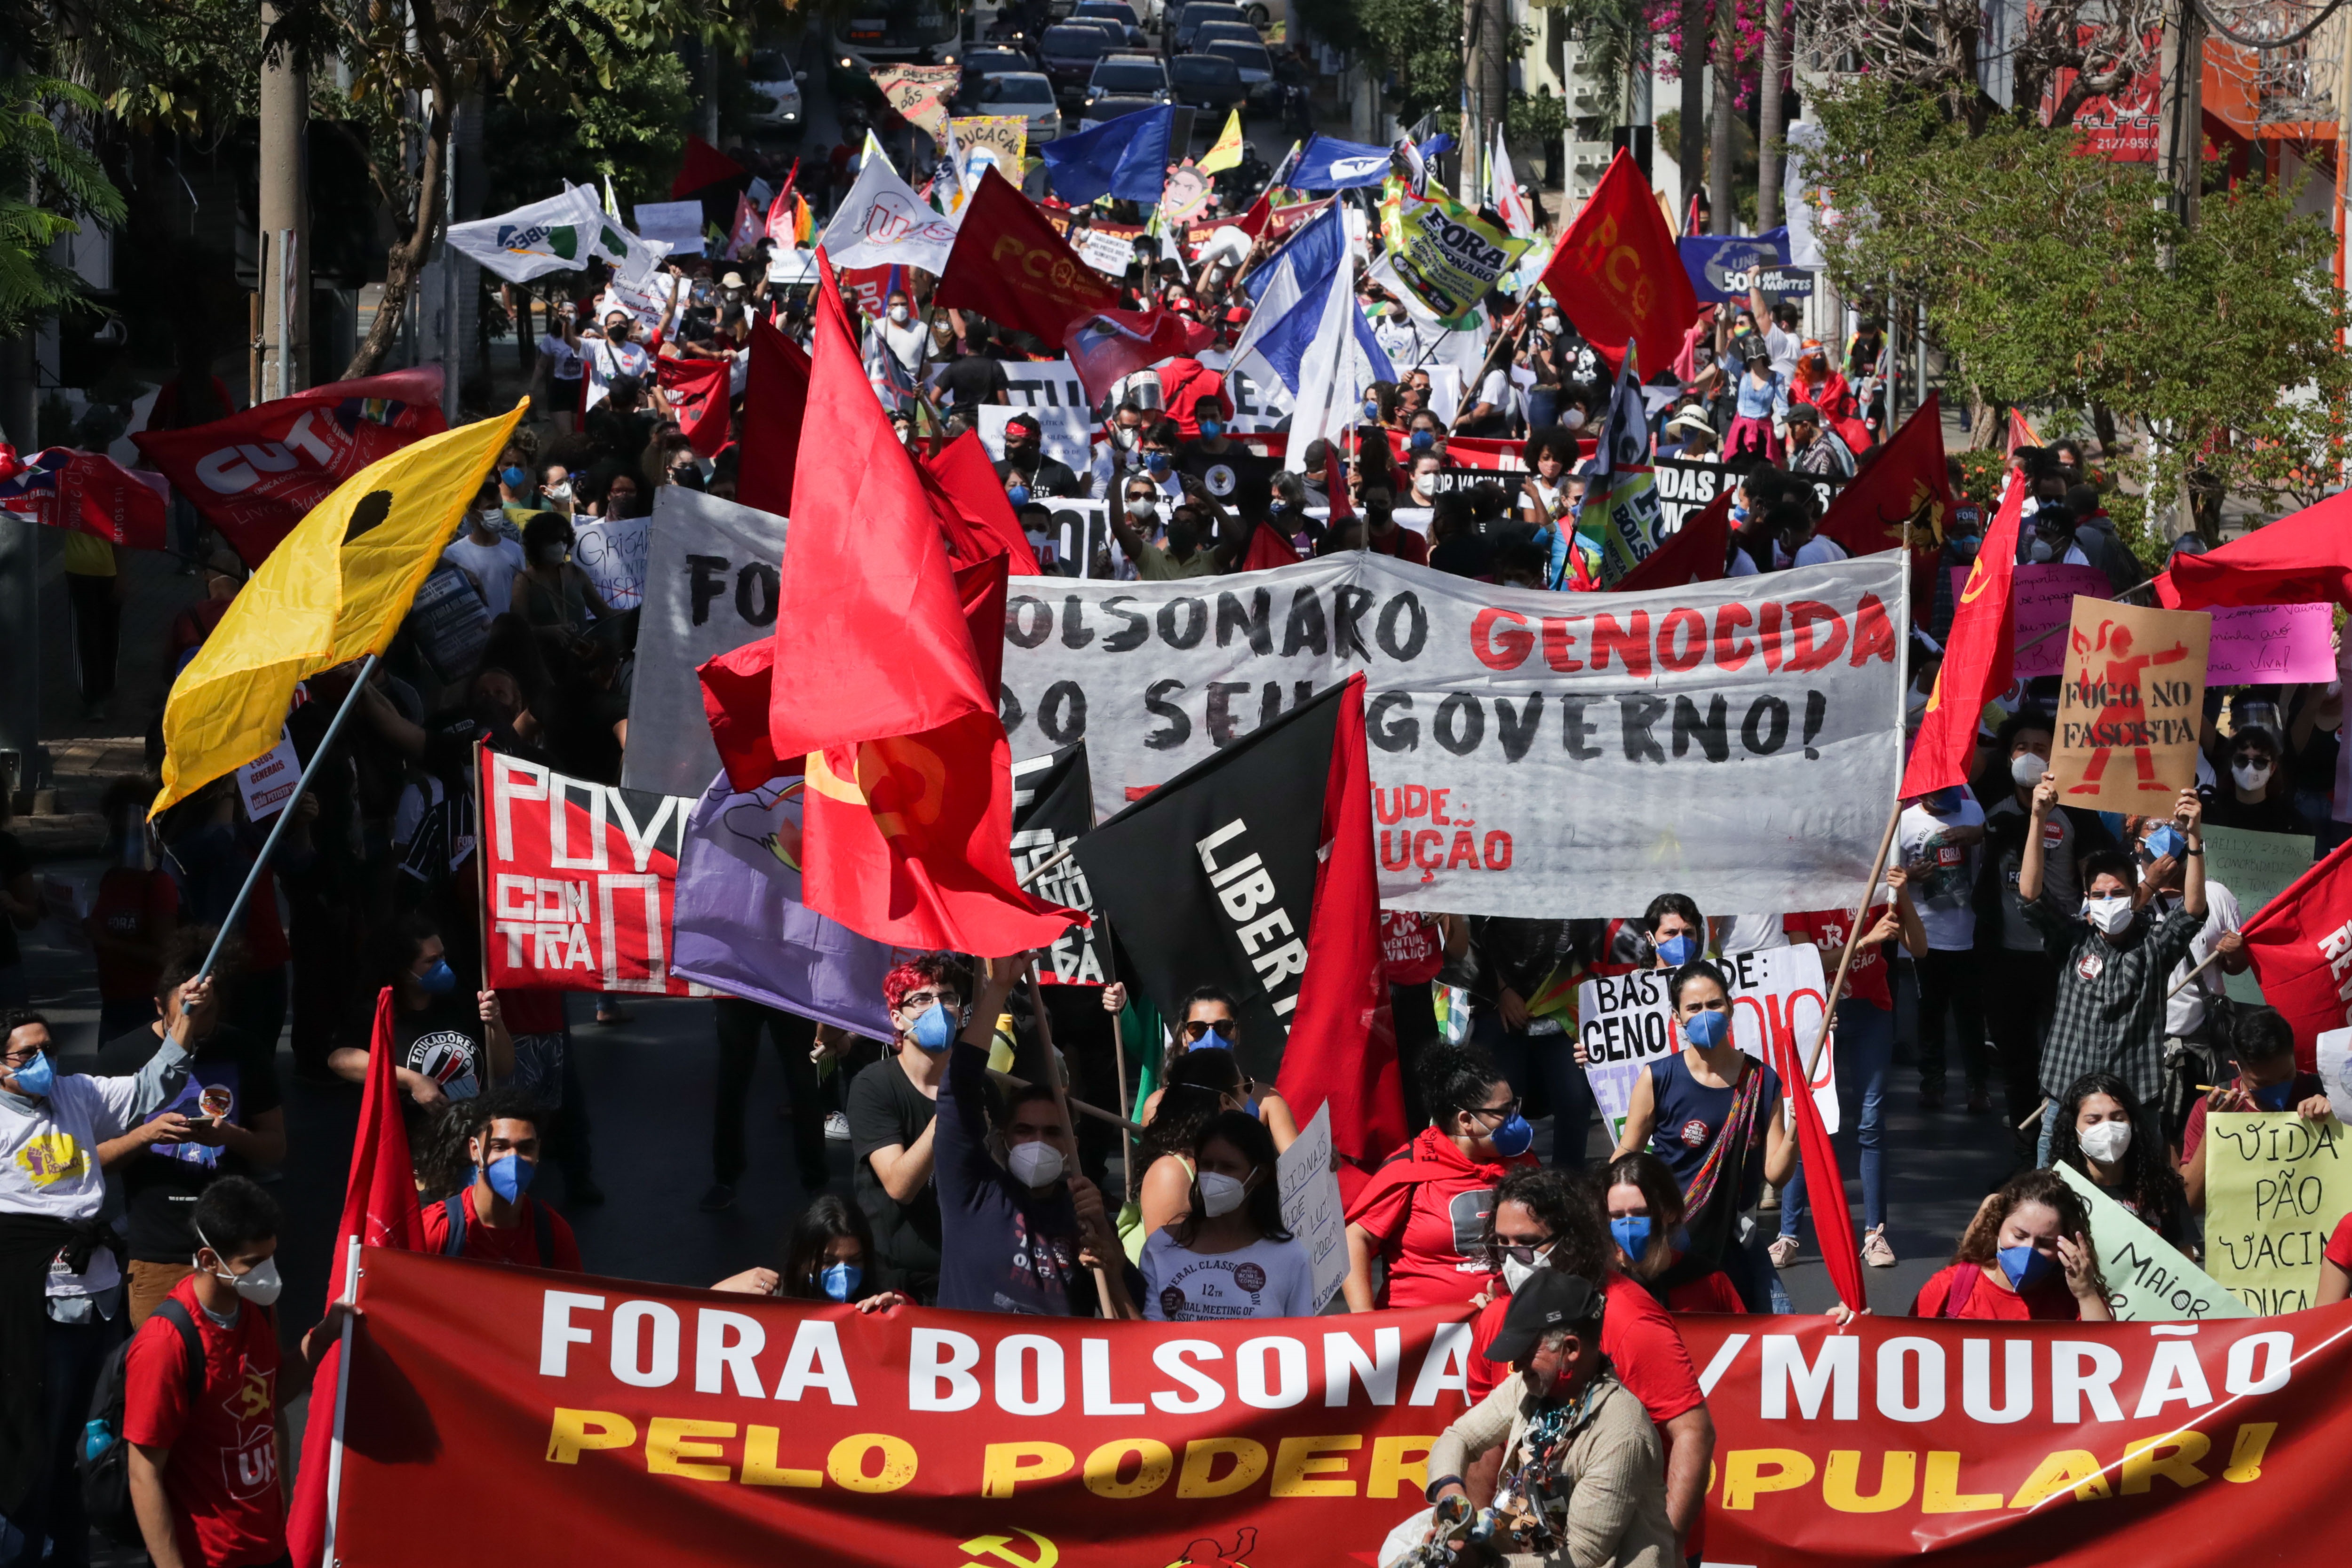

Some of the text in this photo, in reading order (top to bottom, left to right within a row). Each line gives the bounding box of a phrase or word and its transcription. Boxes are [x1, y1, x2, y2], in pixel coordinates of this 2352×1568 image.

[901, 89, 922, 109] DOS
[1417, 218, 1495, 282] BOLSONARO
[1424, 207, 1506, 271] FORA
[1763, 271, 1784, 282] MIL
[1763, 280, 1812, 291] MORTES
[195, 410, 334, 494] CUT
[686, 554, 1897, 679] FO OLSONARO GENOCIDA
[2065, 681, 2192, 709] FOGO NO
[1366, 688, 1828, 765] GOVERNO!
[2063, 717, 2195, 748] FASCISTA
[250, 759, 285, 785] GENERAIS
[1939, 847, 1961, 858] FORA
[1597, 967, 1676, 1014] BAST
[411, 1033, 477, 1064] EDUCADORES
[2216, 1120, 2339, 1162] VIDA
[2257, 1168, 2322, 1221] PÃO
[1199, 1260, 1239, 1273] CLASSI
[1202, 1304, 1241, 1315] MEETING
[1243, 1307, 1255, 1316] OF
[540, 1289, 859, 1407] FORA
[546, 1406, 918, 1495] PELO
[1707, 1422, 2278, 1512] PULAR!
